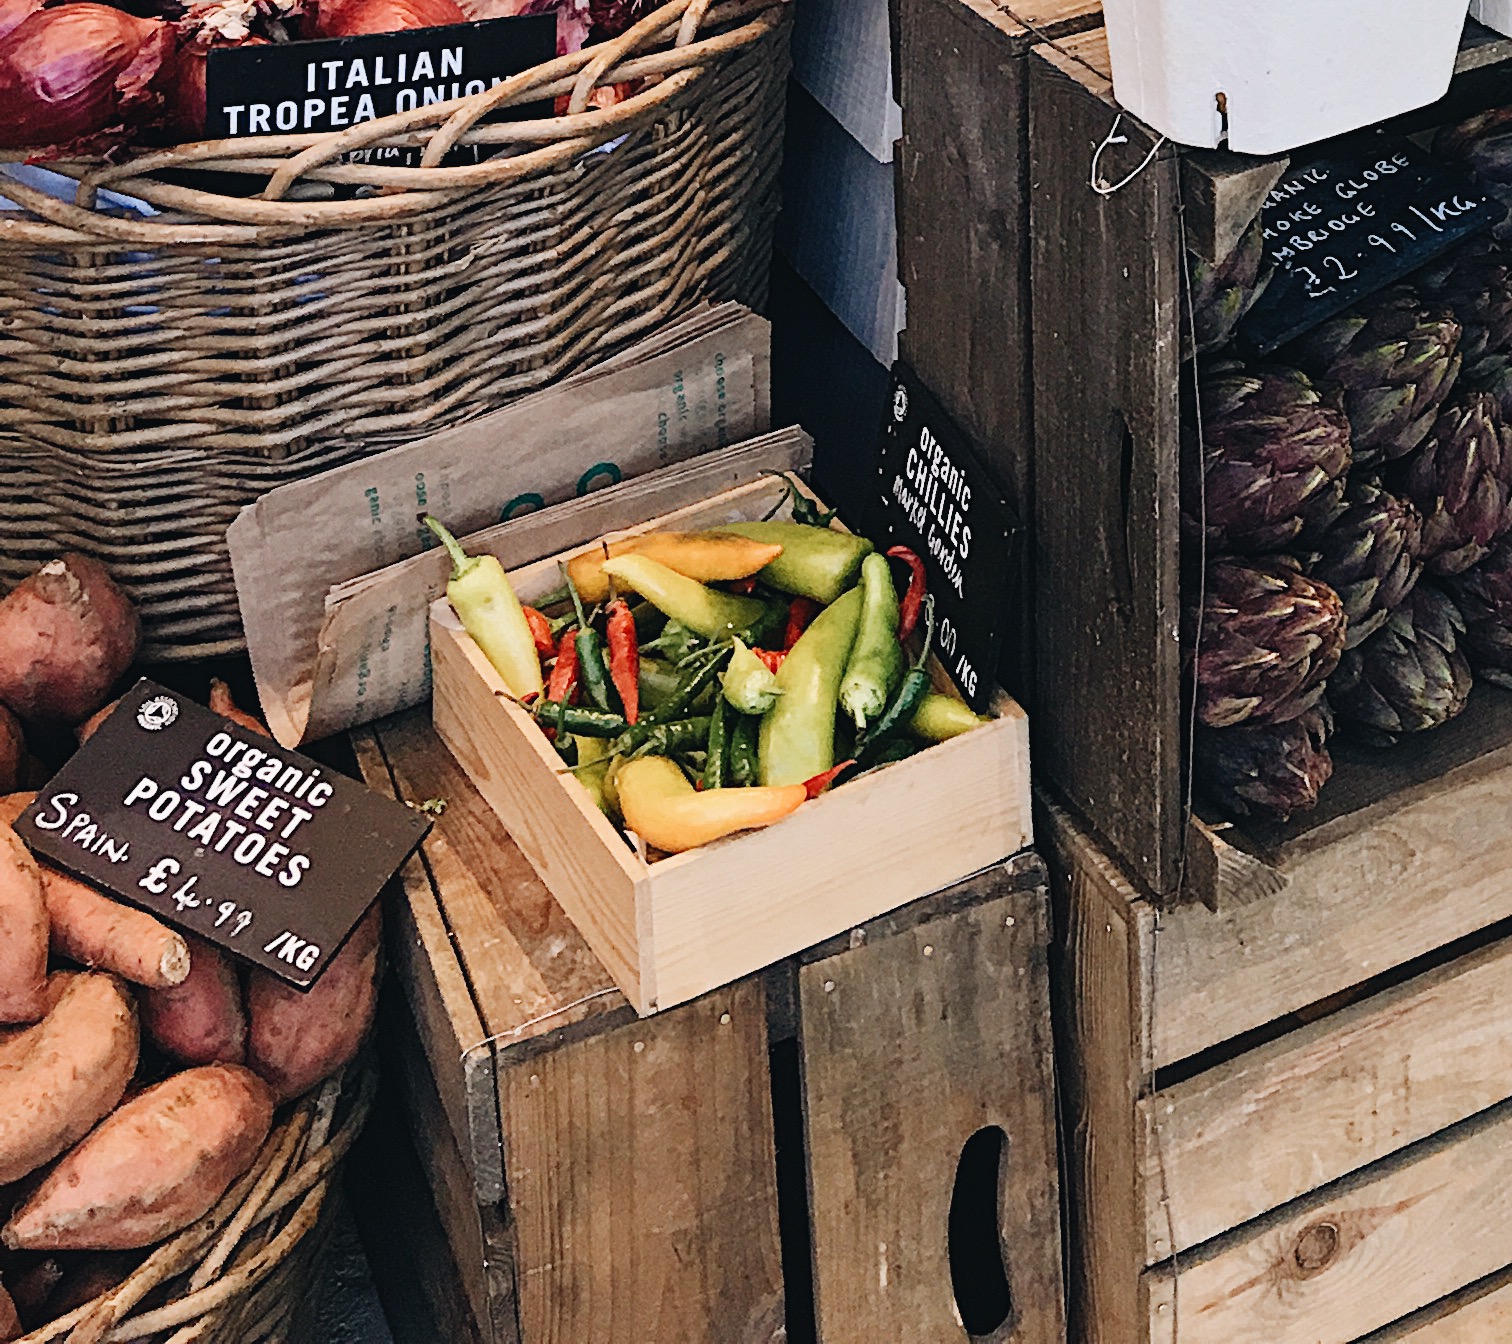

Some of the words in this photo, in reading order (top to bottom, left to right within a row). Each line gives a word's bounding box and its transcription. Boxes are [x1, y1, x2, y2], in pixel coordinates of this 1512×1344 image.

[306, 46, 463, 92] ITALIAN
[223, 93, 376, 134] TROPEA
[1335, 152, 1409, 199] GLOBE
[907, 447, 972, 560] CHILLIES
[920, 427, 972, 512] organic
[180, 761, 312, 841] SWEET
[206, 733, 334, 808] organic
[124, 777, 311, 888] POTATOES
[138, 857, 253, 937] £4.99
[264, 931, 320, 972] /KG
